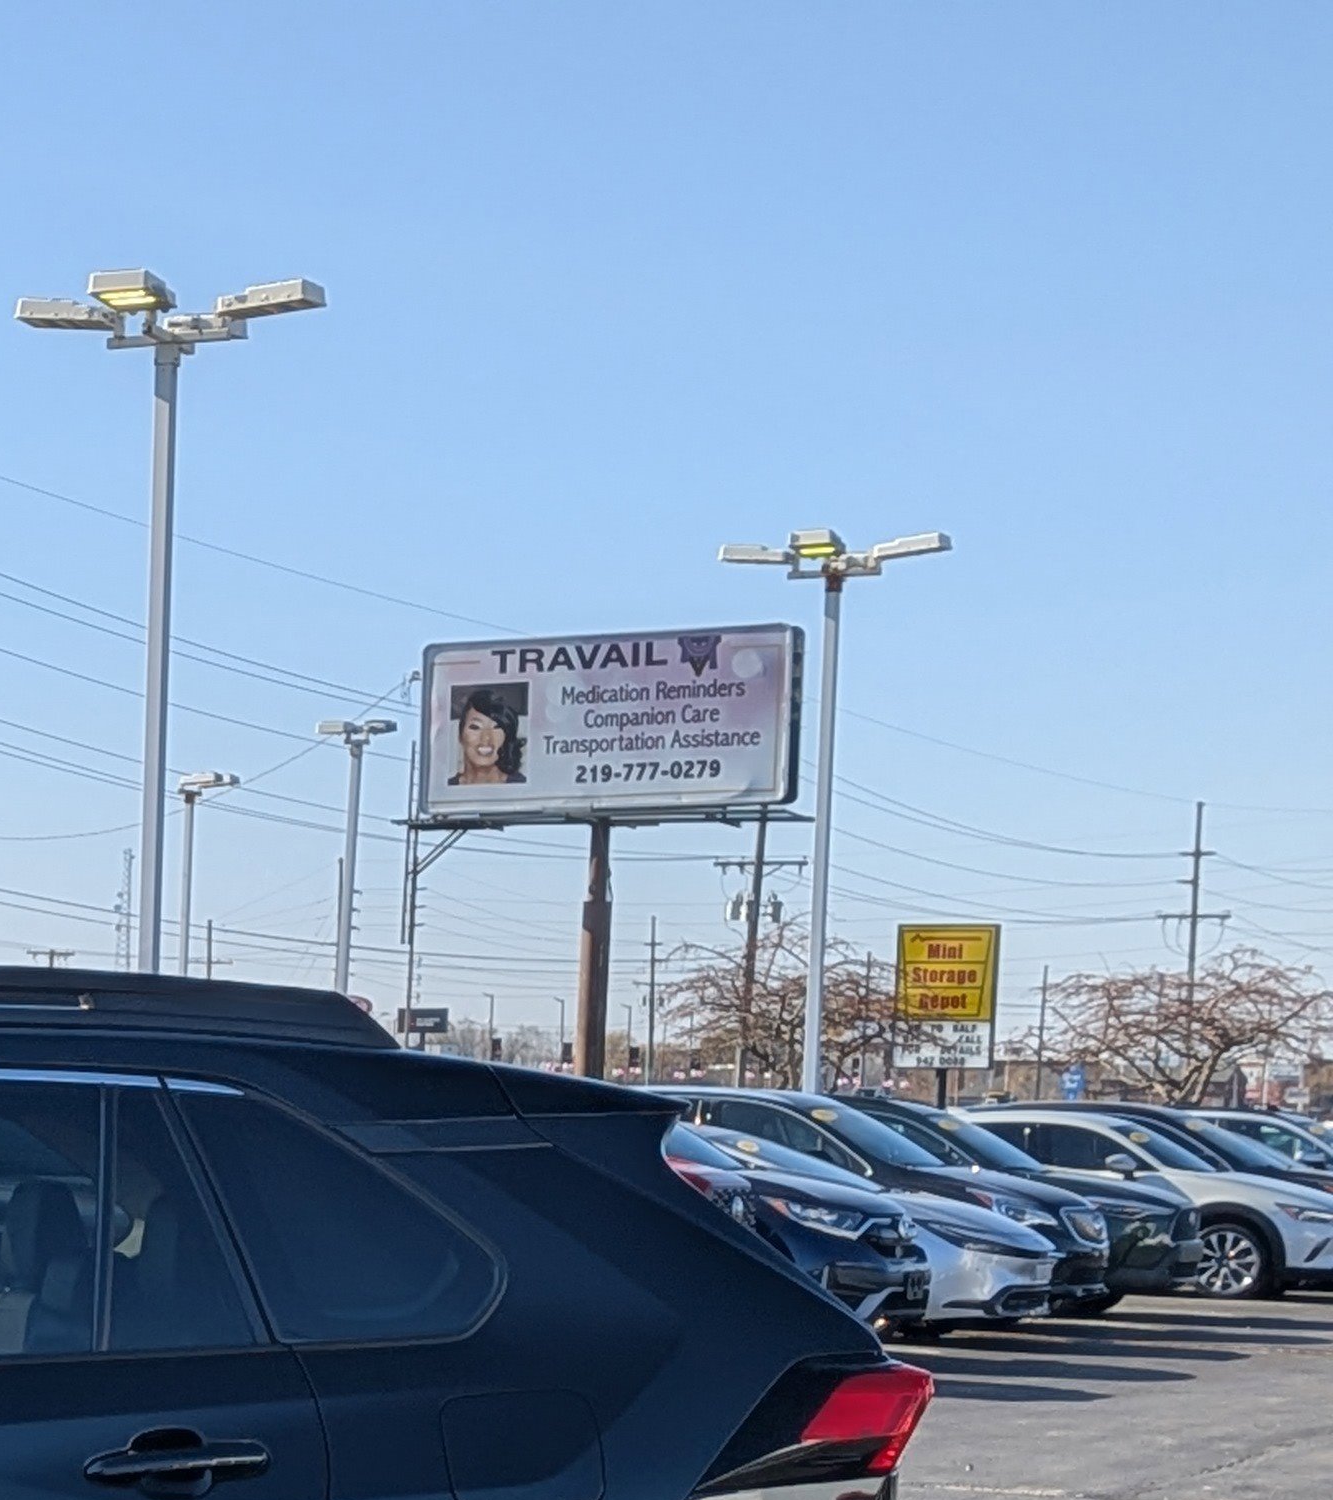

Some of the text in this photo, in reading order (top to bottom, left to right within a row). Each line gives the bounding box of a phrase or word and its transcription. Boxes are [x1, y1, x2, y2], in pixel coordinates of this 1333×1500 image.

[491, 641, 668, 674] TRAVAIL
[561, 678, 746, 705] Medication Reminders
[584, 704, 720, 732] Companion Care
[543, 729, 761, 757] Transportation Assistance
[575, 759, 721, 784] 219-777-0279
[927, 943, 964, 959] Mini
[912, 967, 977, 985] Storage
[918, 993, 968, 1010] Depot
